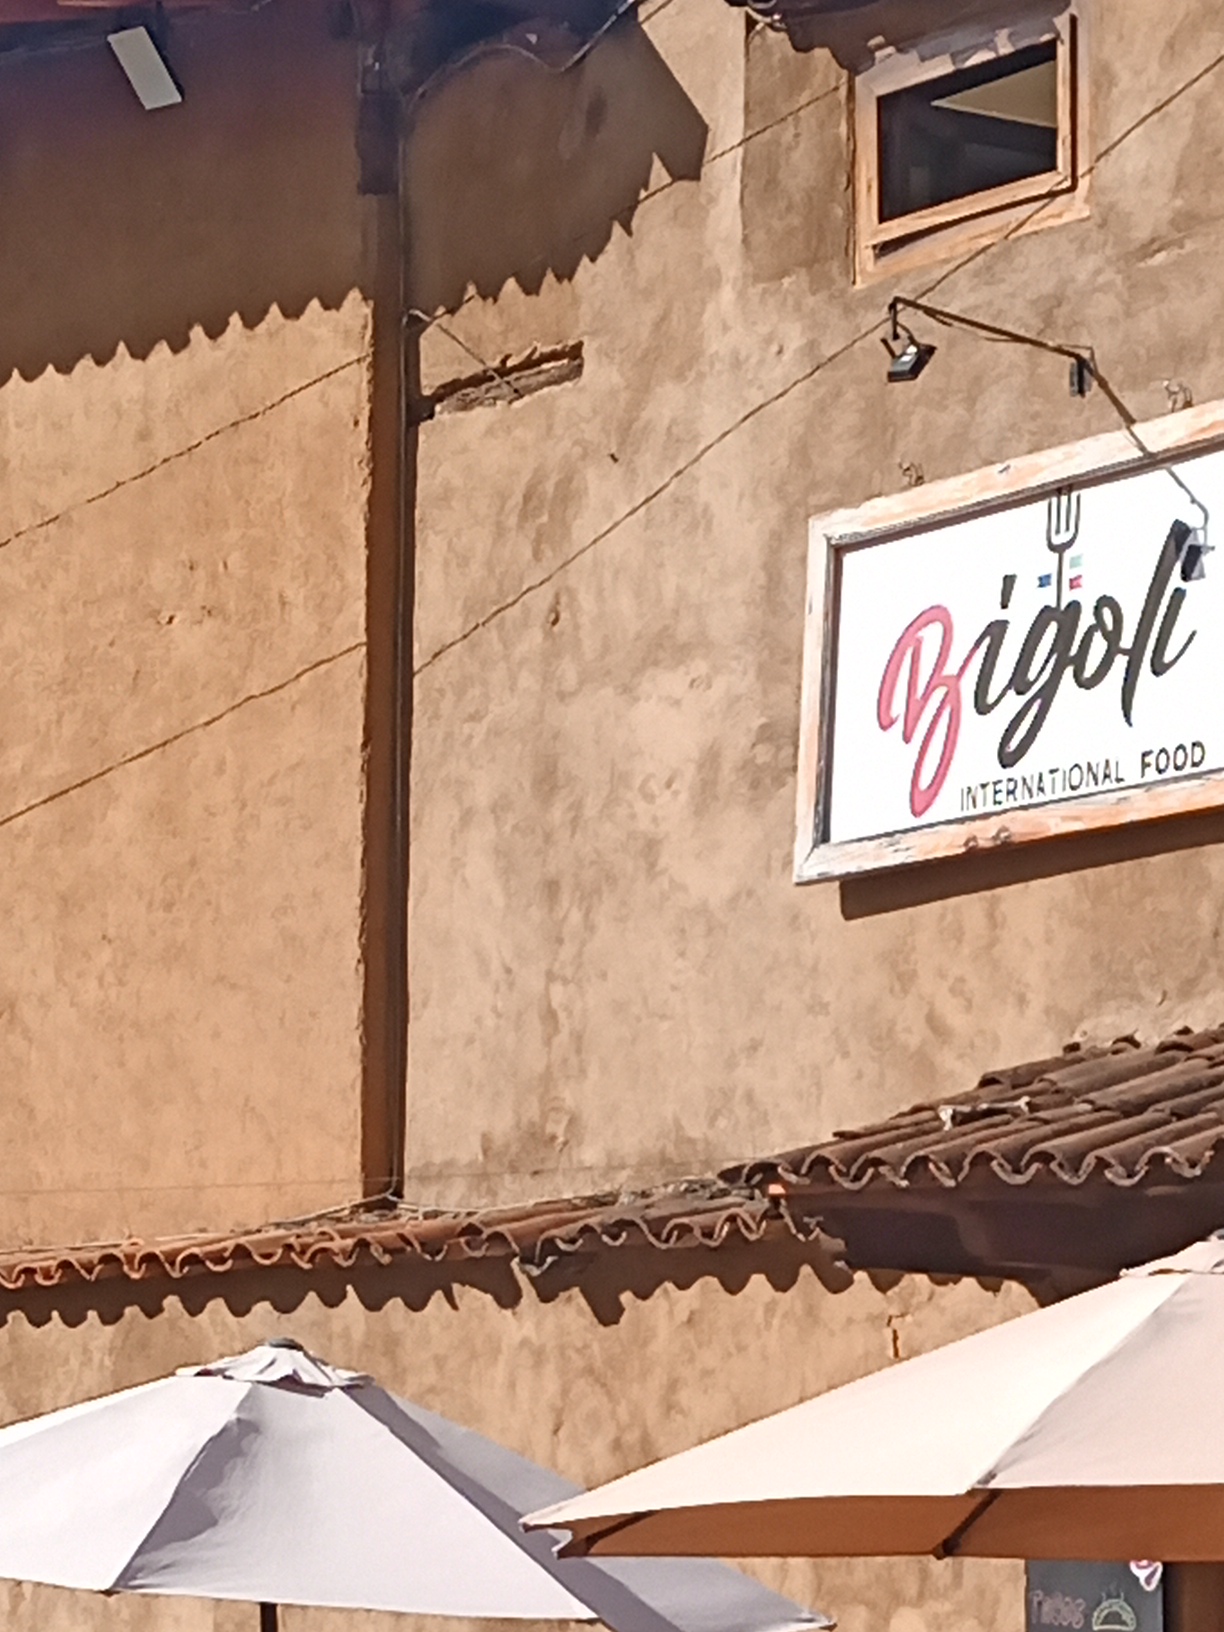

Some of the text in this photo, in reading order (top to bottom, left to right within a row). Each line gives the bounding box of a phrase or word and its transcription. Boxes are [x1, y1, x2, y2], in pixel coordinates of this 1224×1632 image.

[876, 519, 1197, 817] Bigoli
[960, 740, 1206, 811] INTERNATIONAL FOOD
